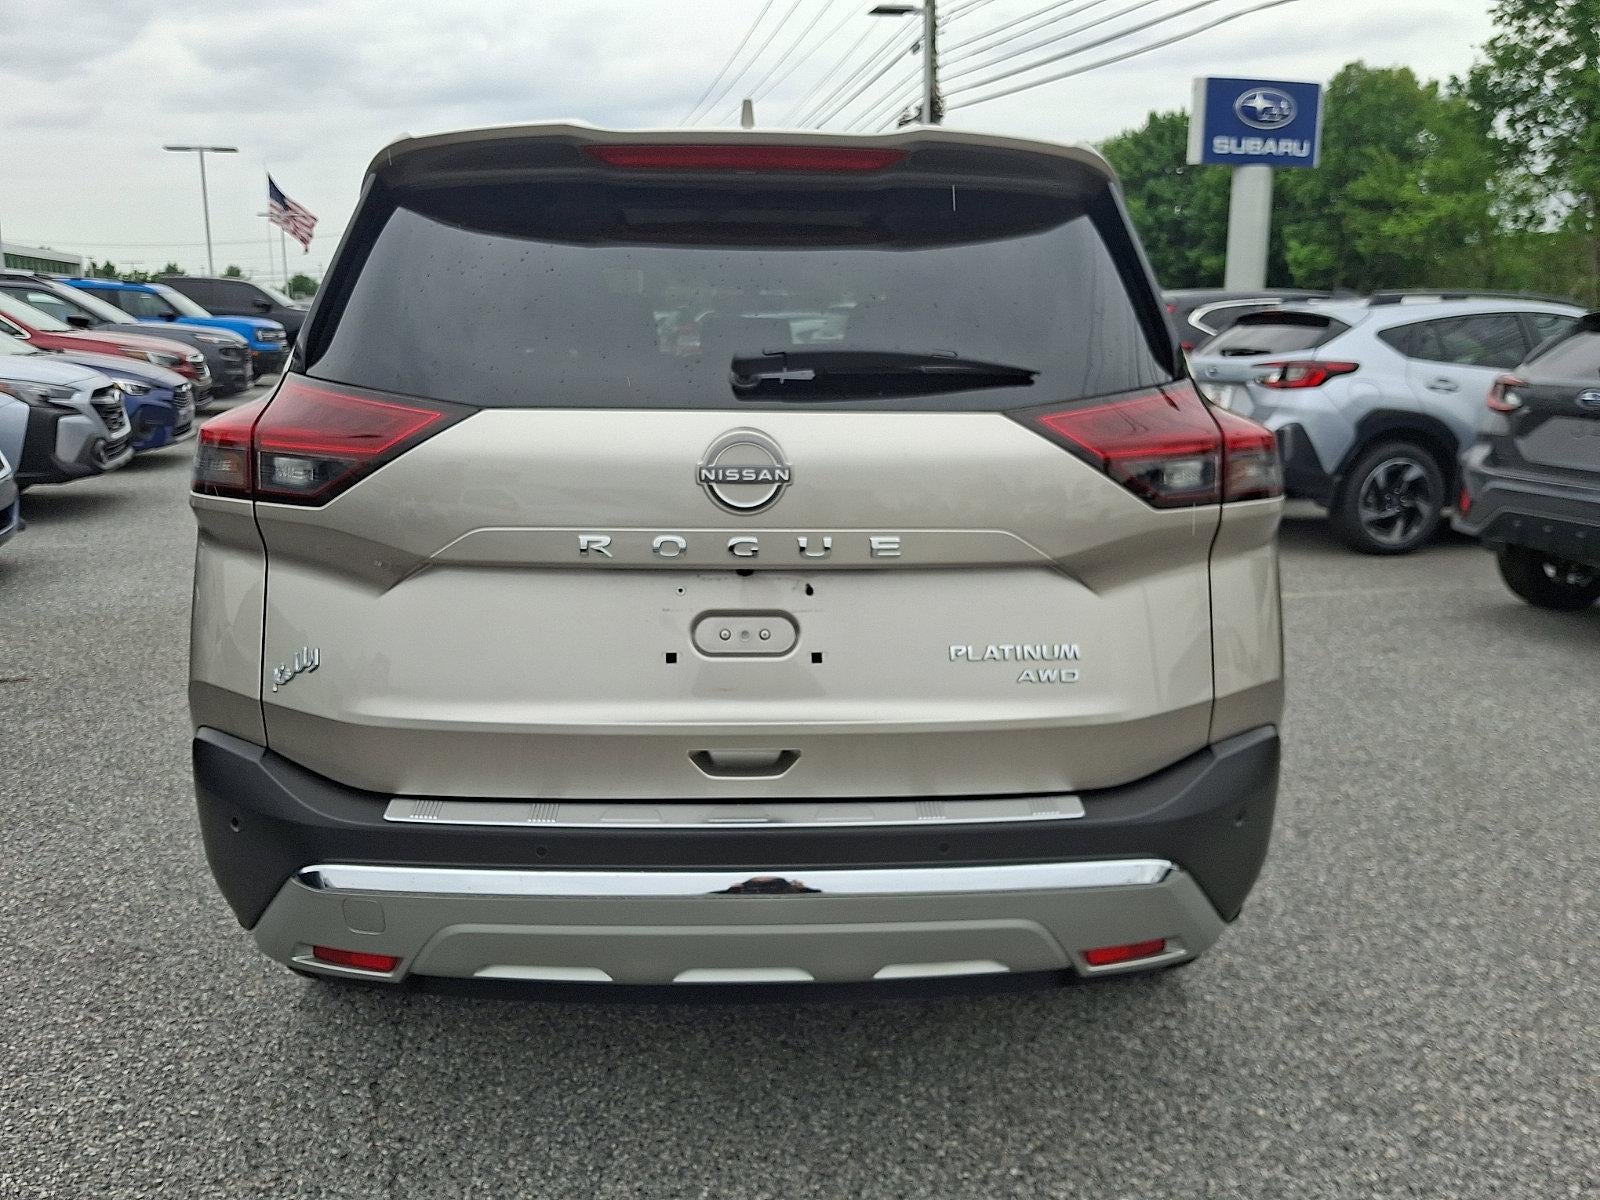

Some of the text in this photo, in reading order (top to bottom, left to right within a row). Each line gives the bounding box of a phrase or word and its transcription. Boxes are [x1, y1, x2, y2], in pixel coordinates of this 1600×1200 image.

[1212, 135, 1311, 158] SUBARU
[699, 468, 791, 482] NISSAN
[578, 534, 901, 558] ROGUE
[949, 643, 1081, 662] PLATINUM
[1017, 668, 1080, 684] AWD
